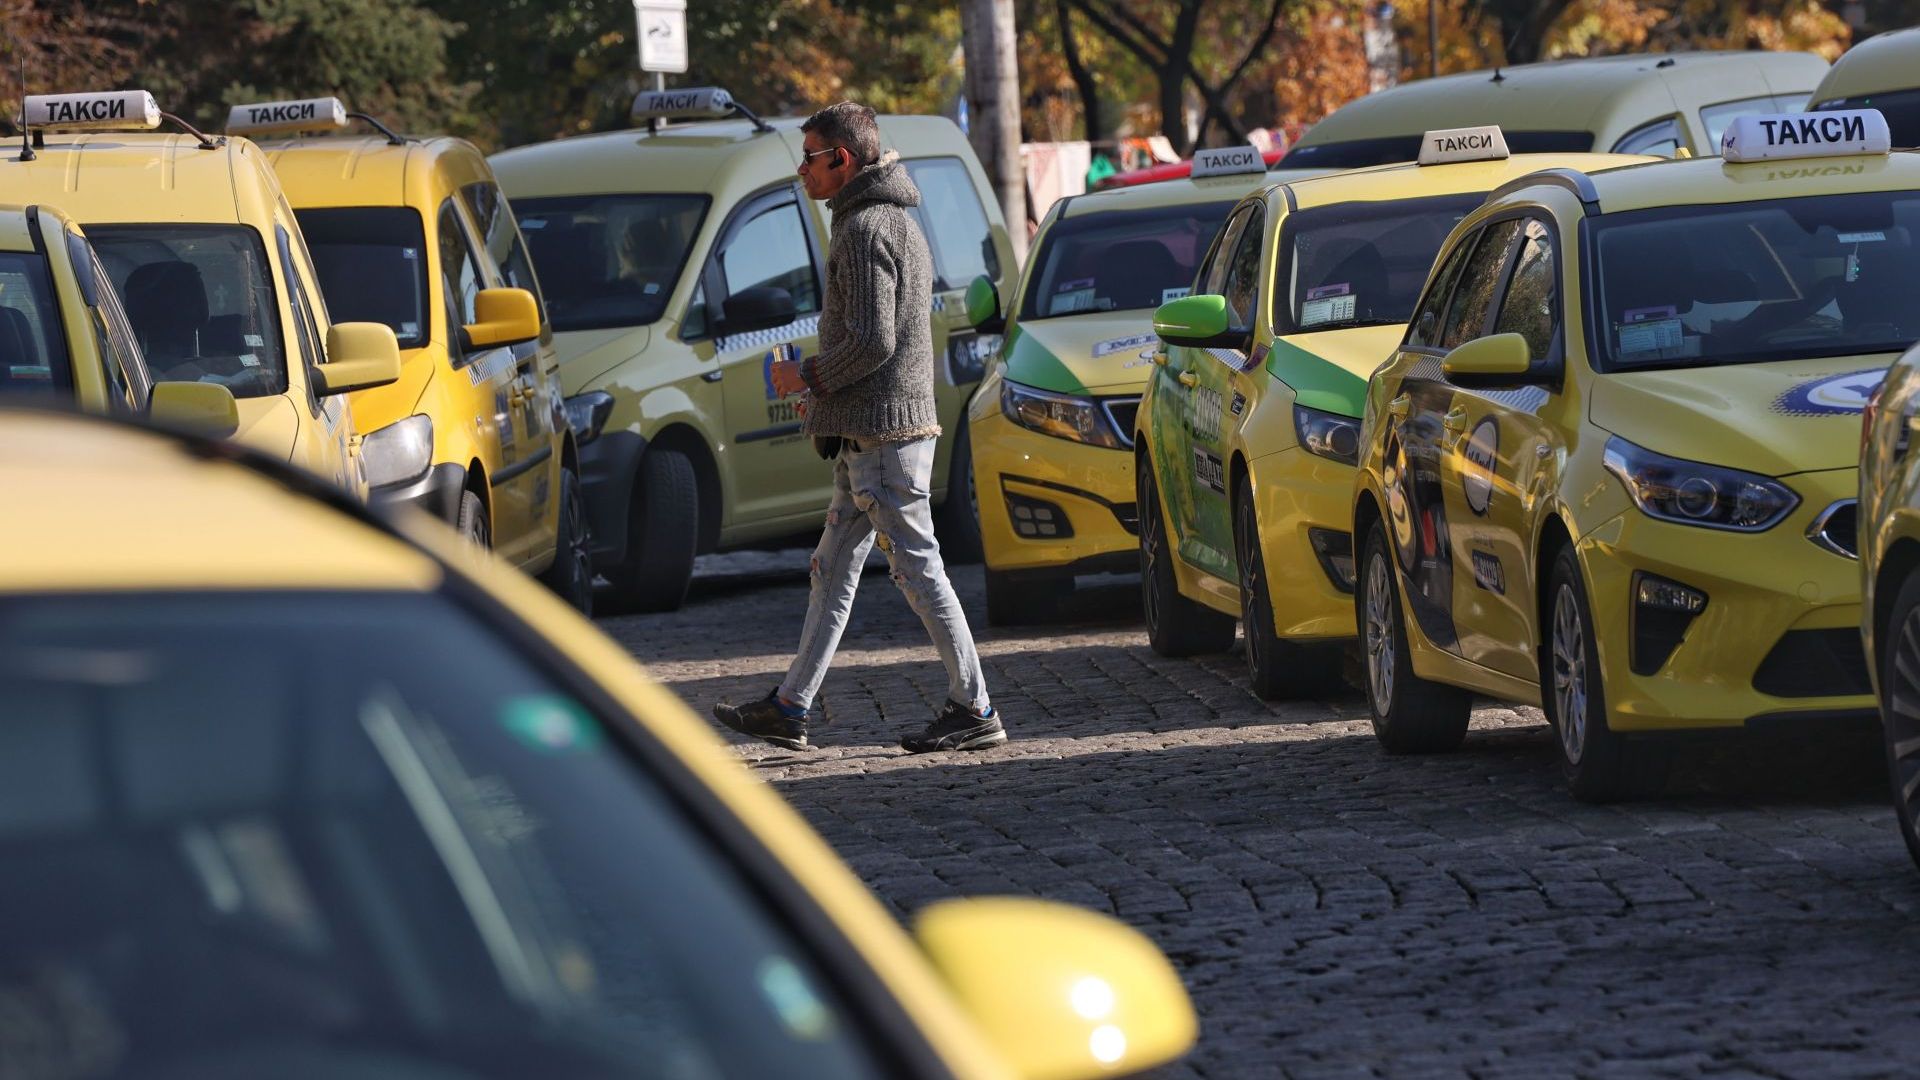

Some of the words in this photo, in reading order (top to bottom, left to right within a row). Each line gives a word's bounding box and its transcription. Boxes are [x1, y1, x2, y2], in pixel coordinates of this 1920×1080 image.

[46, 99, 125, 122] ТАКСИ
[648, 94, 698, 110] ТАКСИ
[248, 103, 314, 124] ТАКСИ
[1759, 115, 1865, 146] ТАКСИ
[1434, 135, 1493, 153] ТАКСИ
[1202, 152, 1254, 169] ТАКСИ
